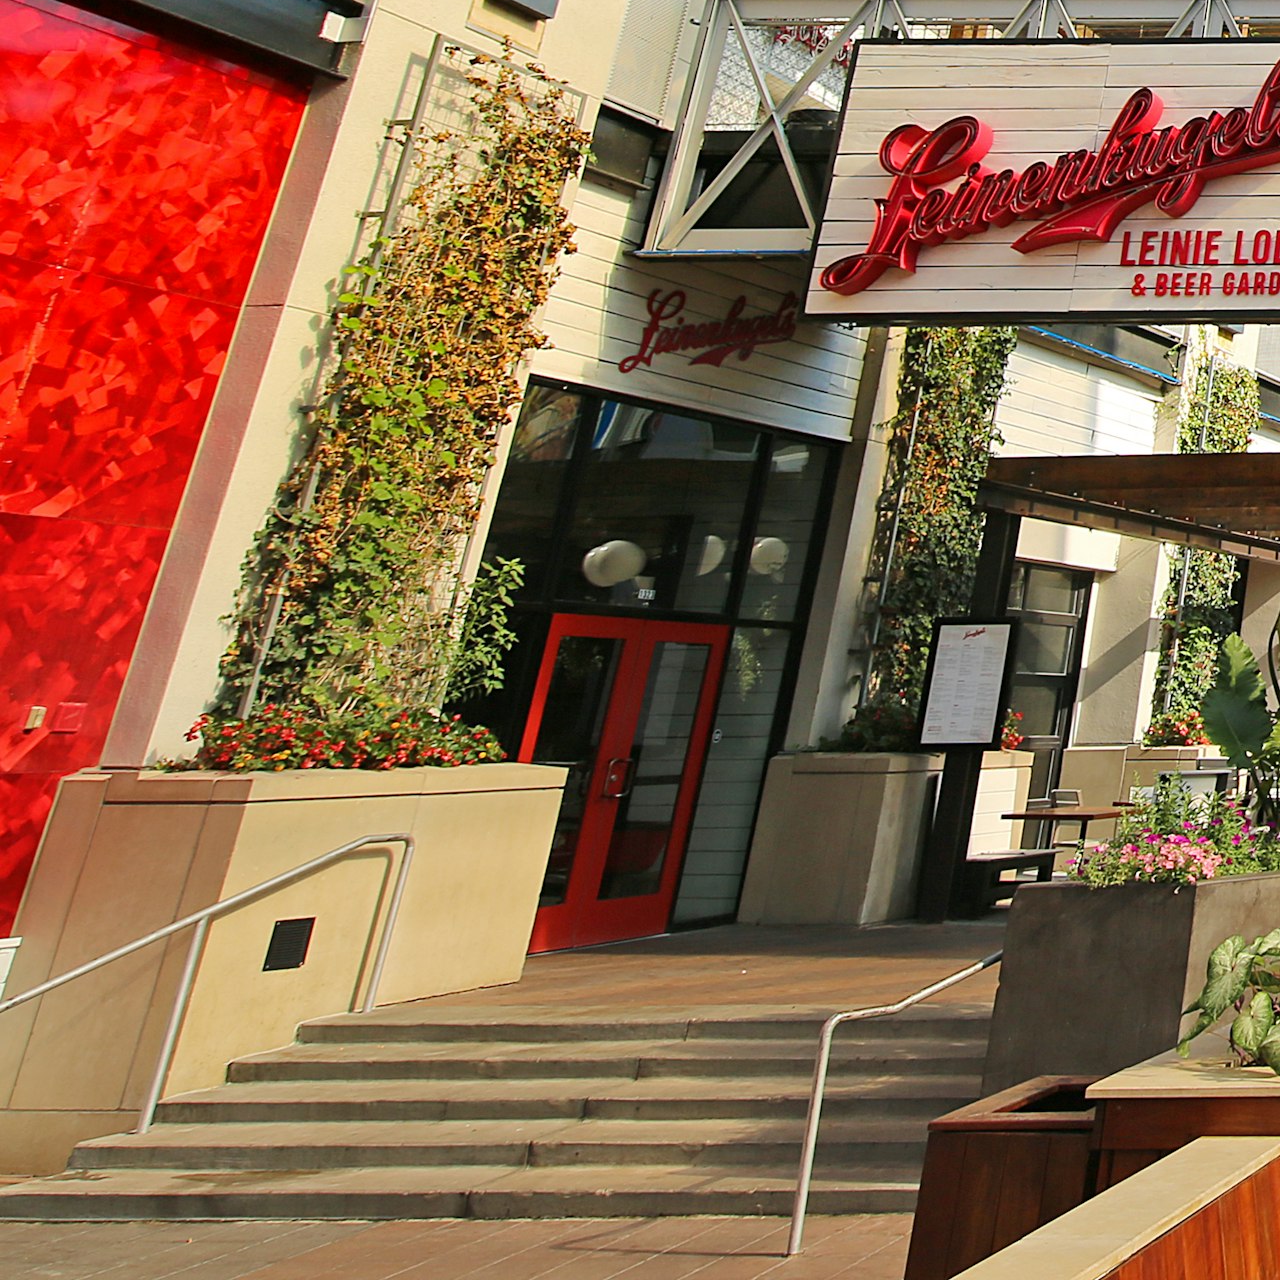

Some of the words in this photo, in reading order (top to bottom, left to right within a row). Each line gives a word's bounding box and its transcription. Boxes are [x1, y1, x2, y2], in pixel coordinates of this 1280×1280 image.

[1120, 230, 1221, 267] LEINIE
[1131, 273, 1148, 296] &
[1155, 272, 1212, 297] BEER
